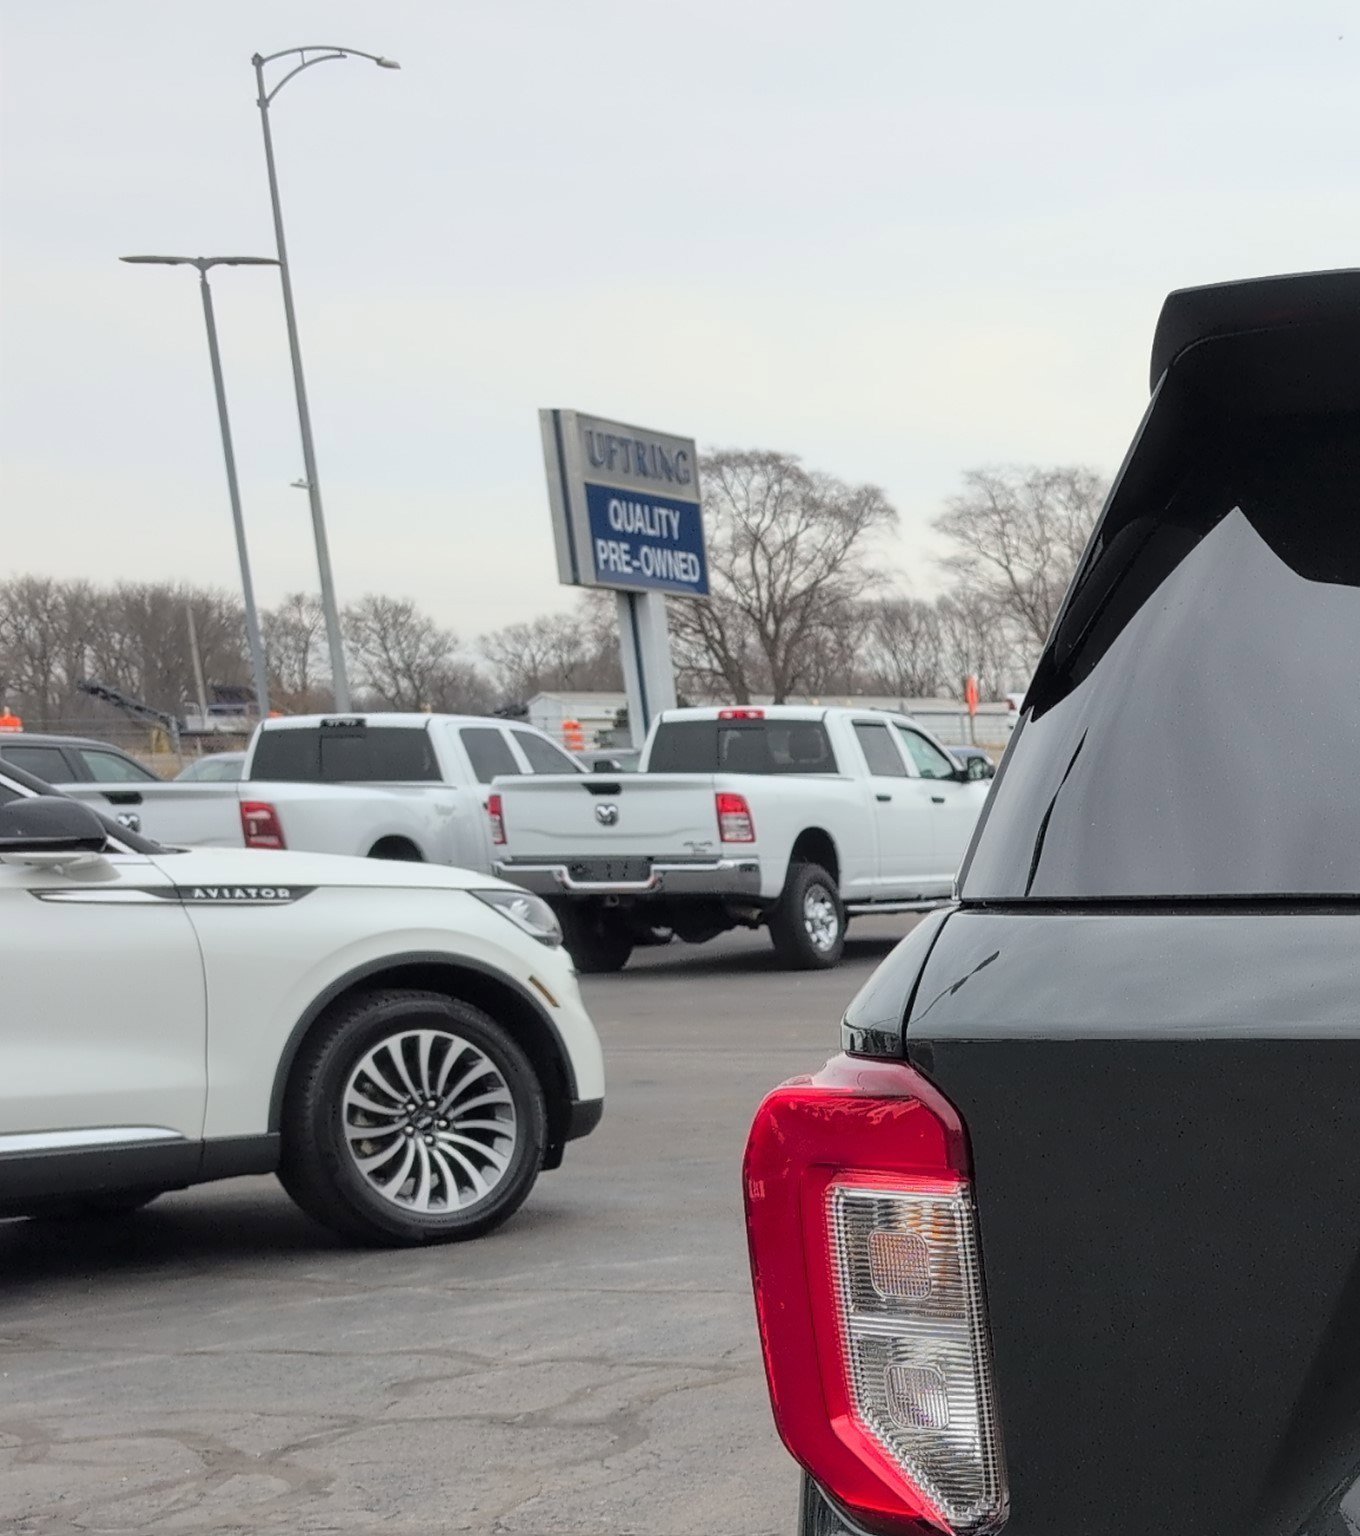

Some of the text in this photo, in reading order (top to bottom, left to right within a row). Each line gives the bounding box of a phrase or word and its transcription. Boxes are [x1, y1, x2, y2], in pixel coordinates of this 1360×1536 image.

[585, 430, 691, 485] UFTRING
[608, 499, 681, 540] QUALITY
[596, 538, 700, 583] PRE-OWNED
[193, 887, 291, 899] AVIATOR
